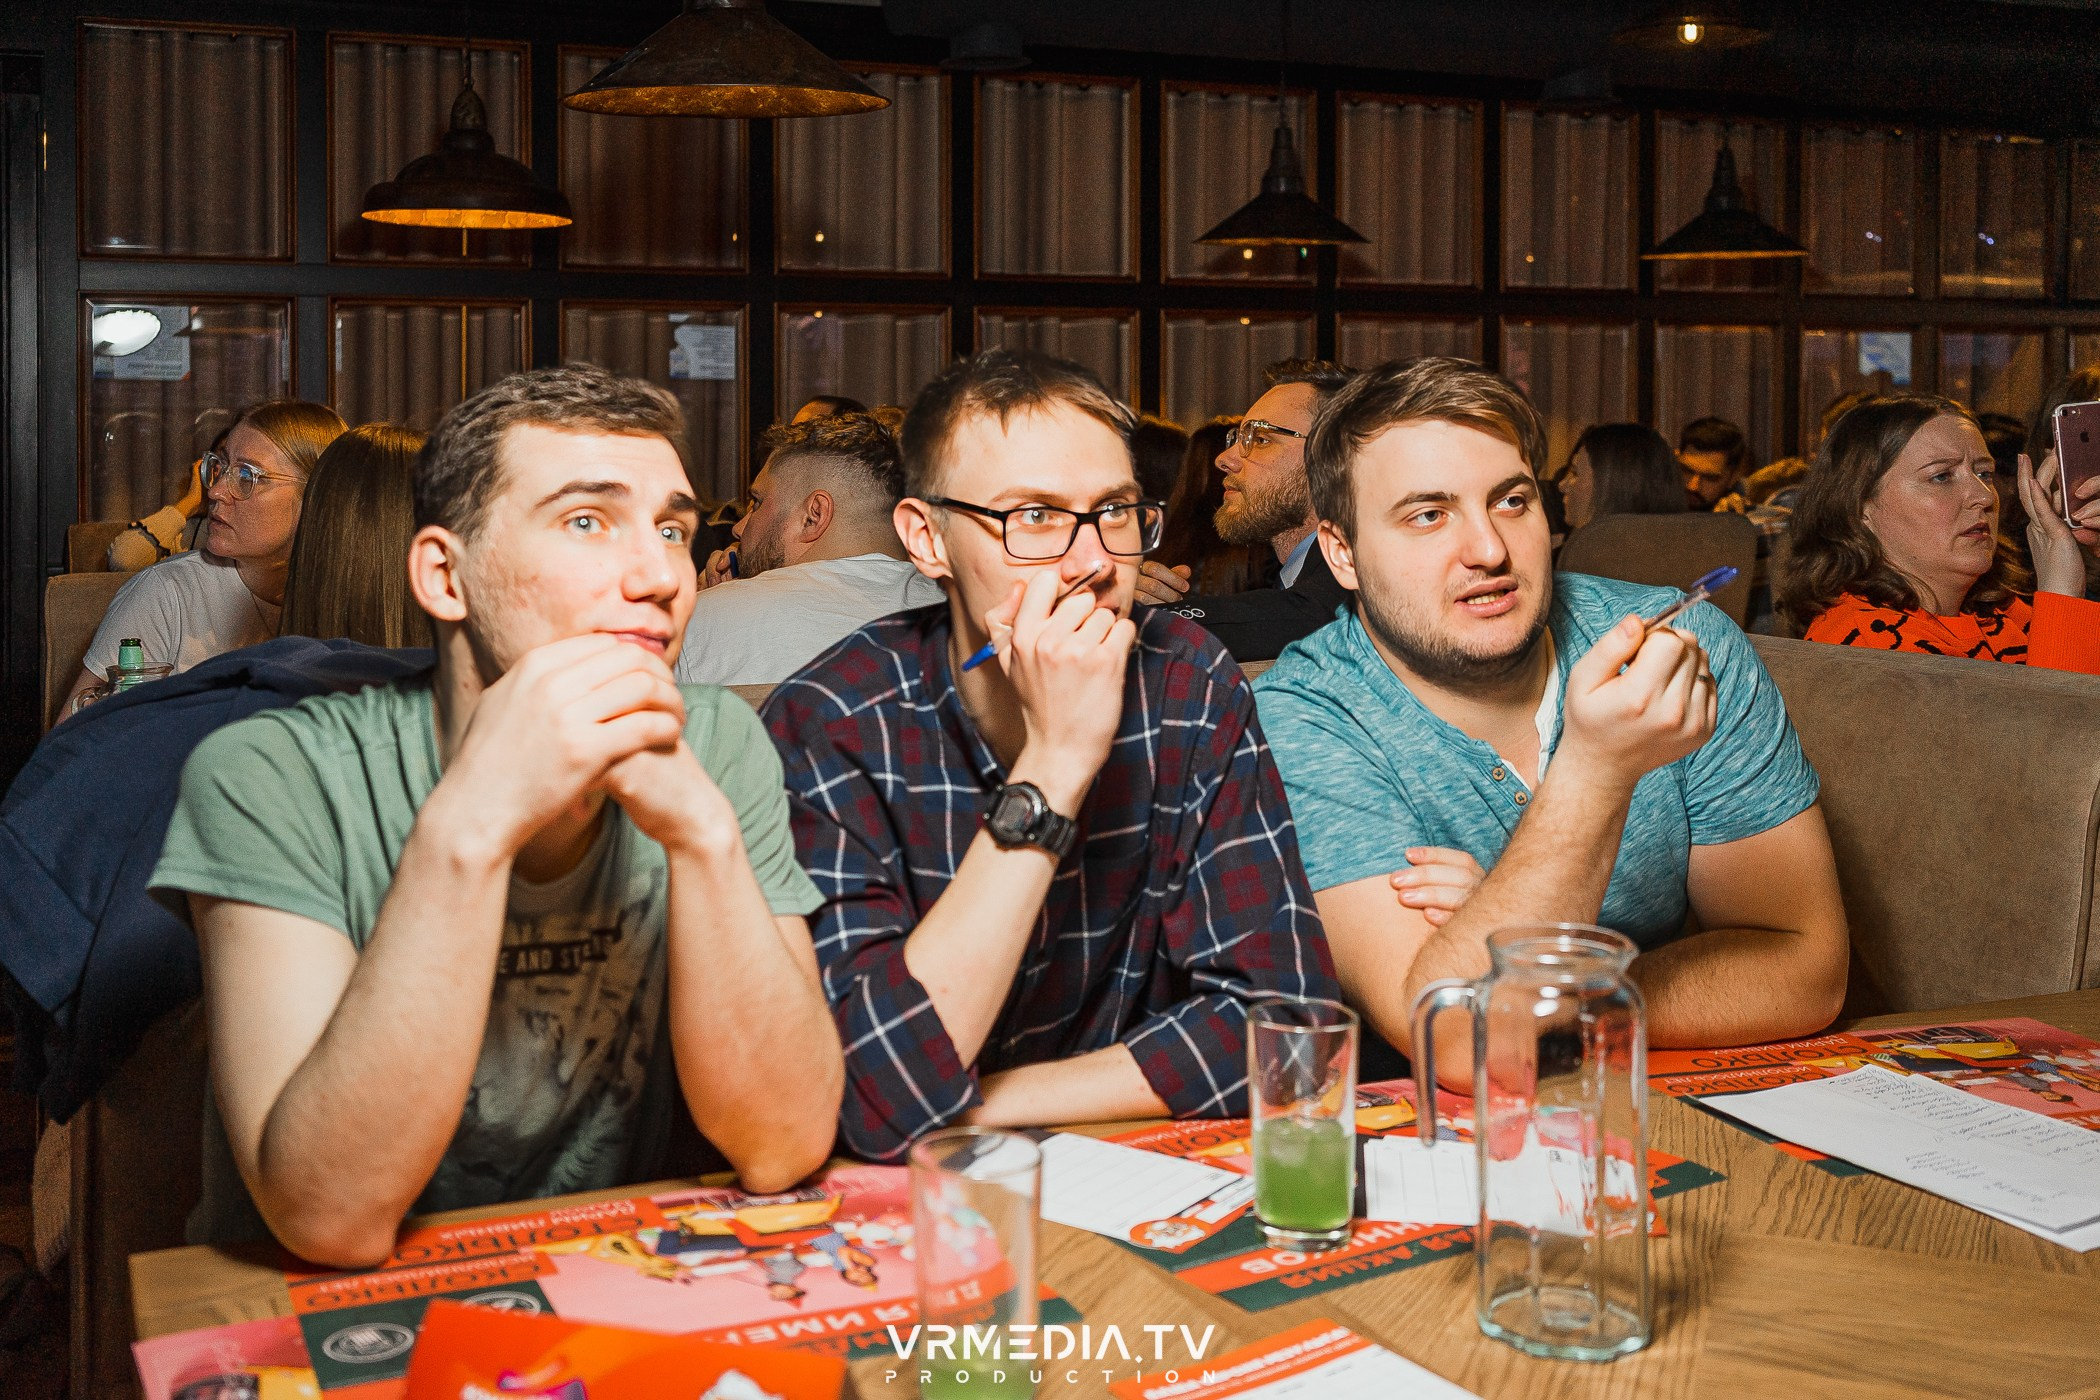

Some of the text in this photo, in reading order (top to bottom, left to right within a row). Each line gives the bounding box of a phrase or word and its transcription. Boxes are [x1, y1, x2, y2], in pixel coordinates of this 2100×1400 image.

[516, 949, 552, 974] AND
[1789, 1037, 1848, 1050] ДАРИМ
[1691, 1045, 1868, 1068] СТОЛЬКО
[1667, 1073, 1828, 1093] СКОЛЬКО
[1693, 1066, 1812, 1082] ИСПОЛНИЛОСЬ
[395, 1217, 644, 1261] СТОЛЬКО
[306, 1263, 541, 1307] СКОЛЬКО
